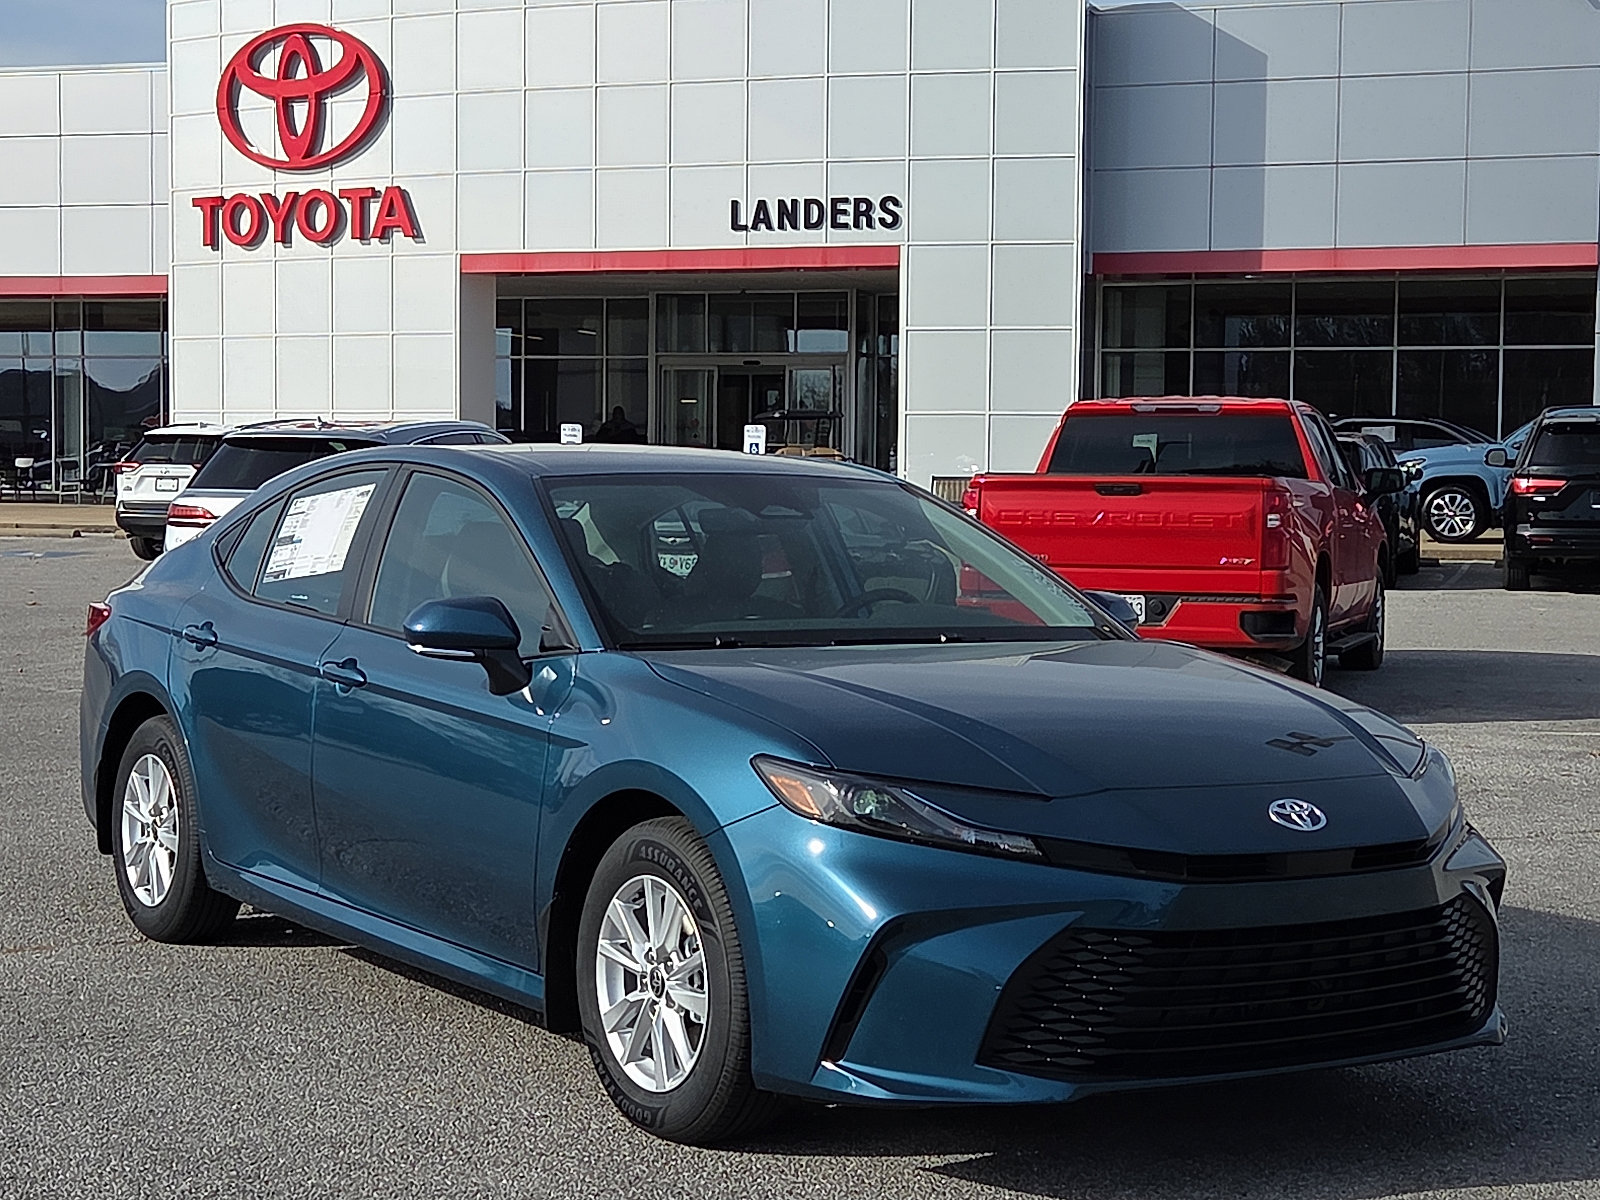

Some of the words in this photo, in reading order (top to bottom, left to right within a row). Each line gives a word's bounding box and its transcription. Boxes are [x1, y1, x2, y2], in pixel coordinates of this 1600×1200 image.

[192, 186, 418, 247] TOYOTA
[730, 195, 902, 232] LANDERS
[998, 510, 1243, 528] CHEVROLET
[639, 845, 704, 911] ASSURANCE
